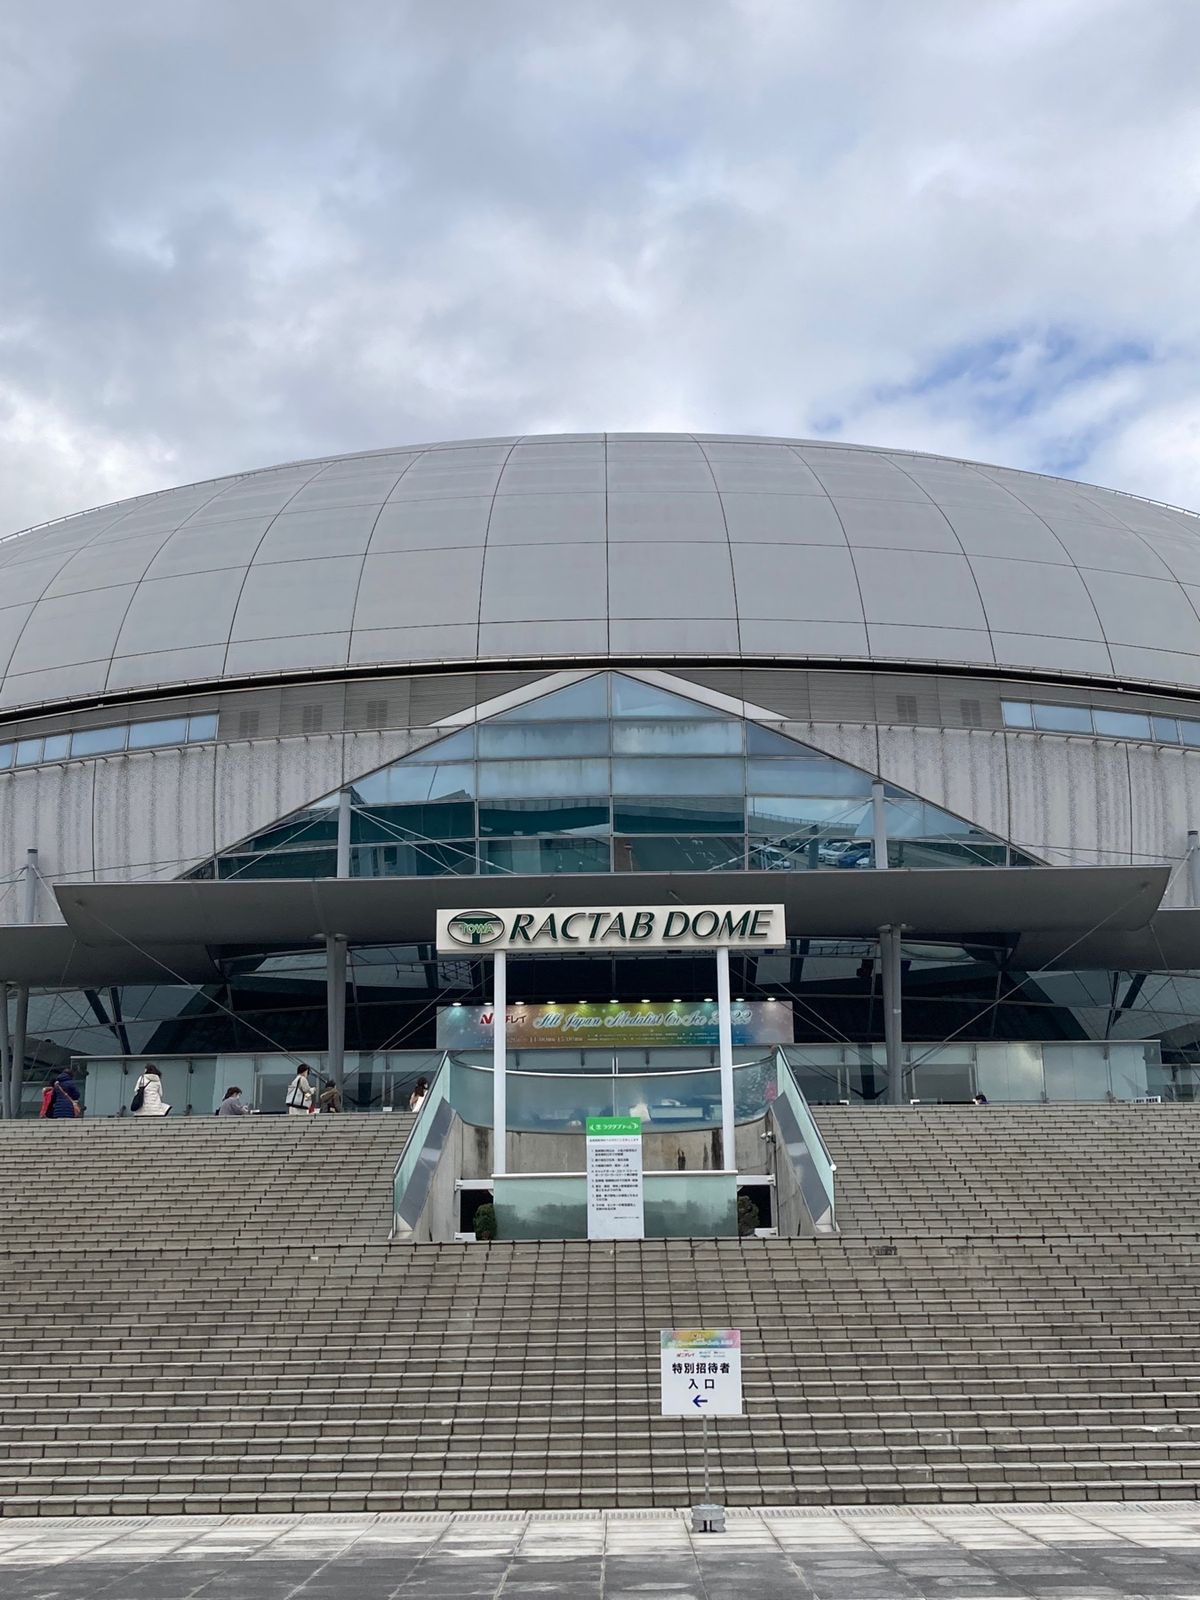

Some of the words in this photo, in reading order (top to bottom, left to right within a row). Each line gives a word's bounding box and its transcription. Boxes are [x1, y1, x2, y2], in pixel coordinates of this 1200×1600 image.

[459, 922, 495, 935] TOWA
[508, 910, 656, 943] RACTAB
[662, 909, 775, 941] DOME
[534, 1013, 563, 1028] All
[564, 1013, 602, 1031] Japan
[605, 1011, 663, 1027] Medalist
[664, 1010, 682, 1026] On
[682, 1011, 706, 1026] Ice
[708, 1009, 753, 1026] 222
[671, 1362, 730, 1374] 特別招待者
[688, 1378, 715, 1390] 入口
